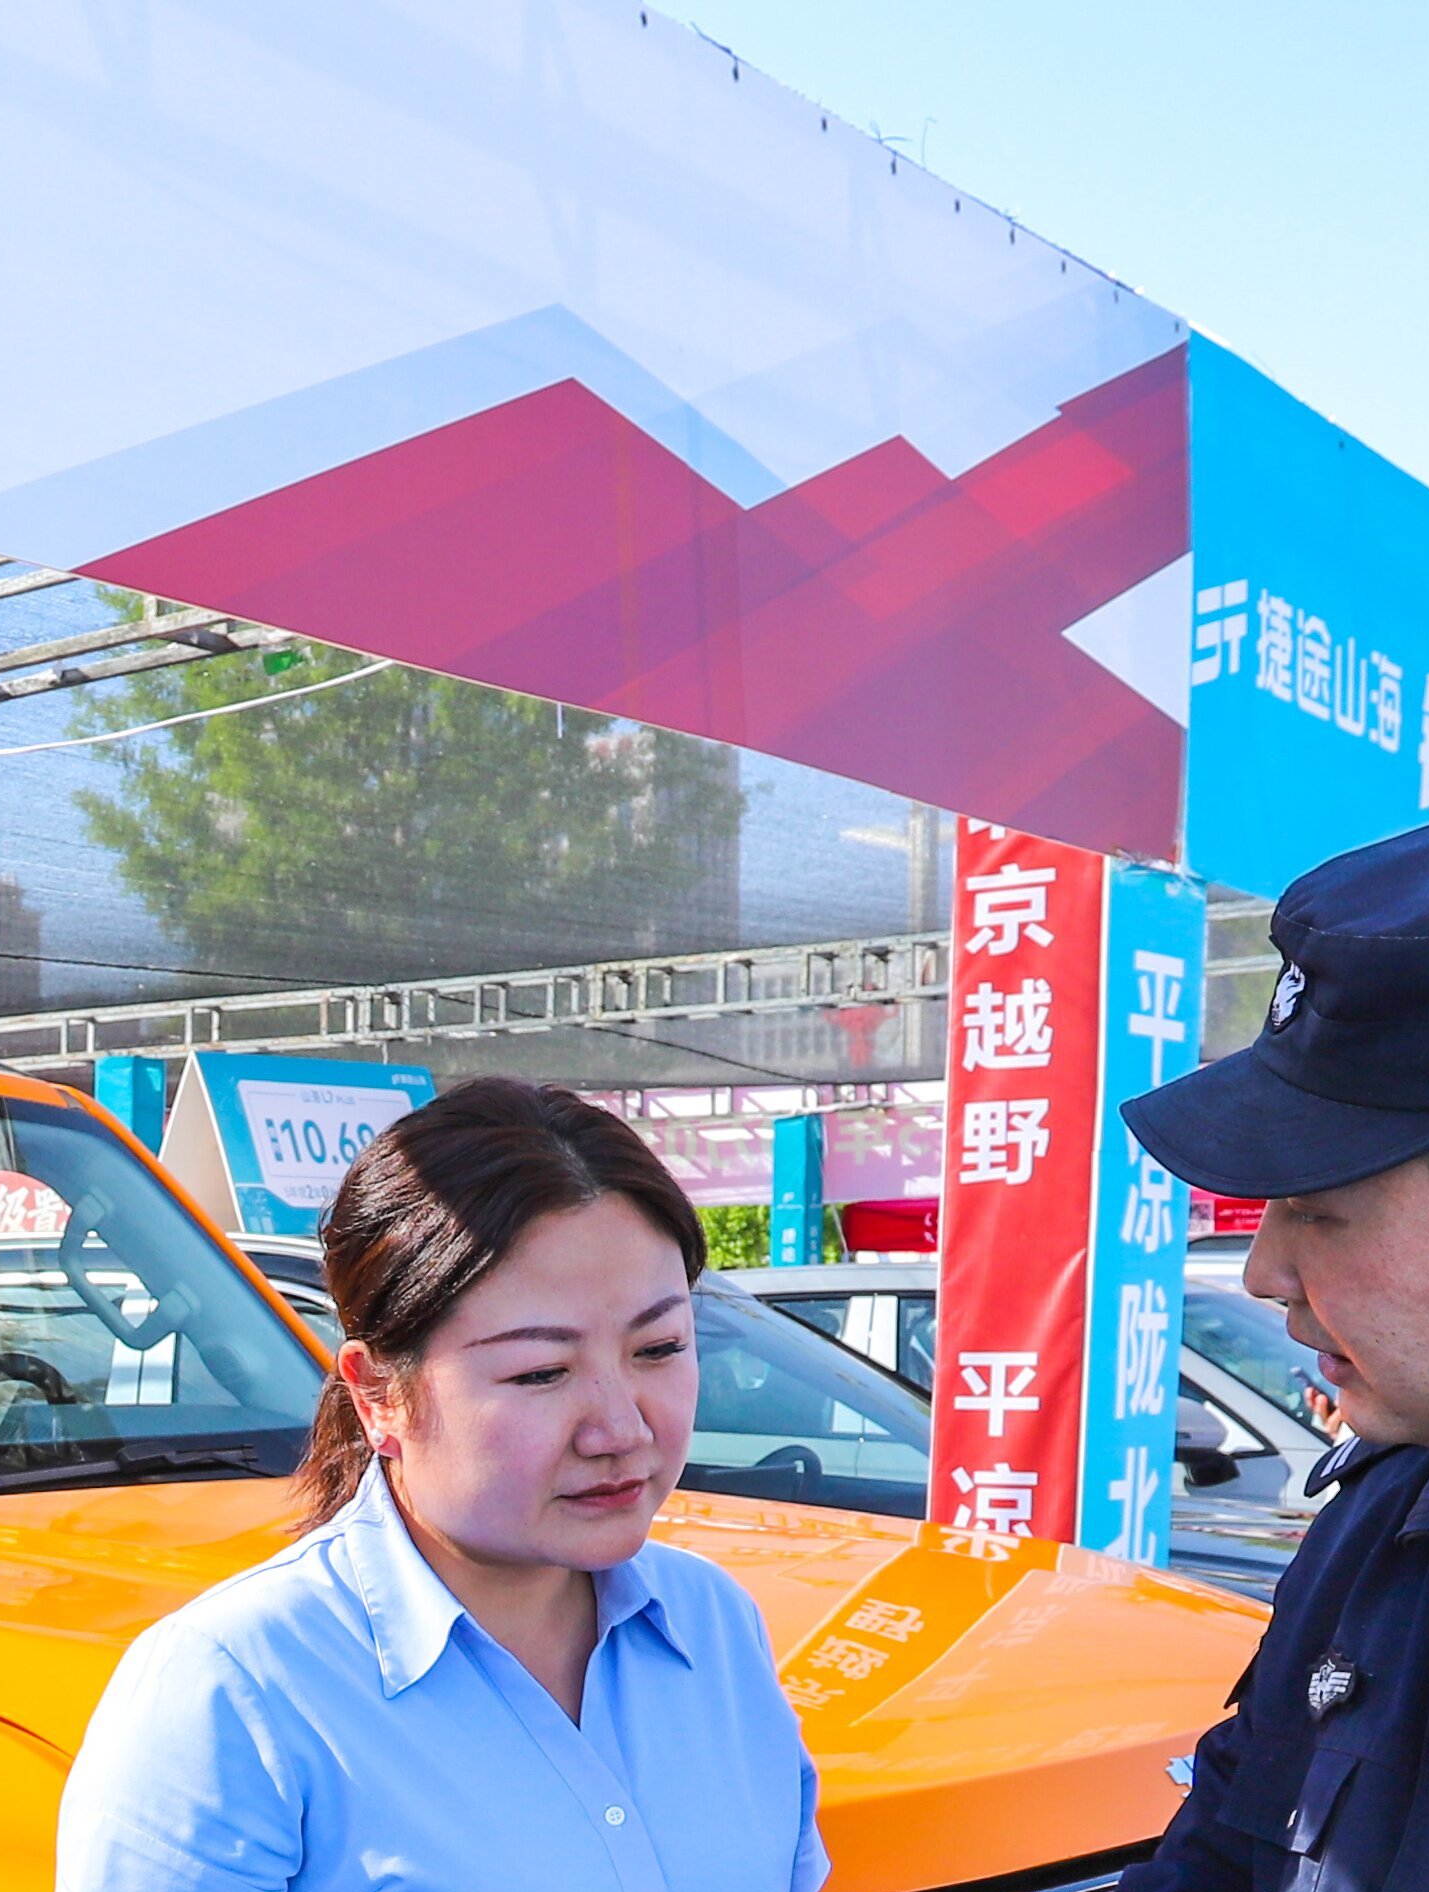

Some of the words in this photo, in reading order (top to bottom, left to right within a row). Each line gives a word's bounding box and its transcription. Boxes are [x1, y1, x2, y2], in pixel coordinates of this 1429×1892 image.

[1256, 588, 1403, 753] 捷途山海
[959, 818, 1057, 1186] 京越野
